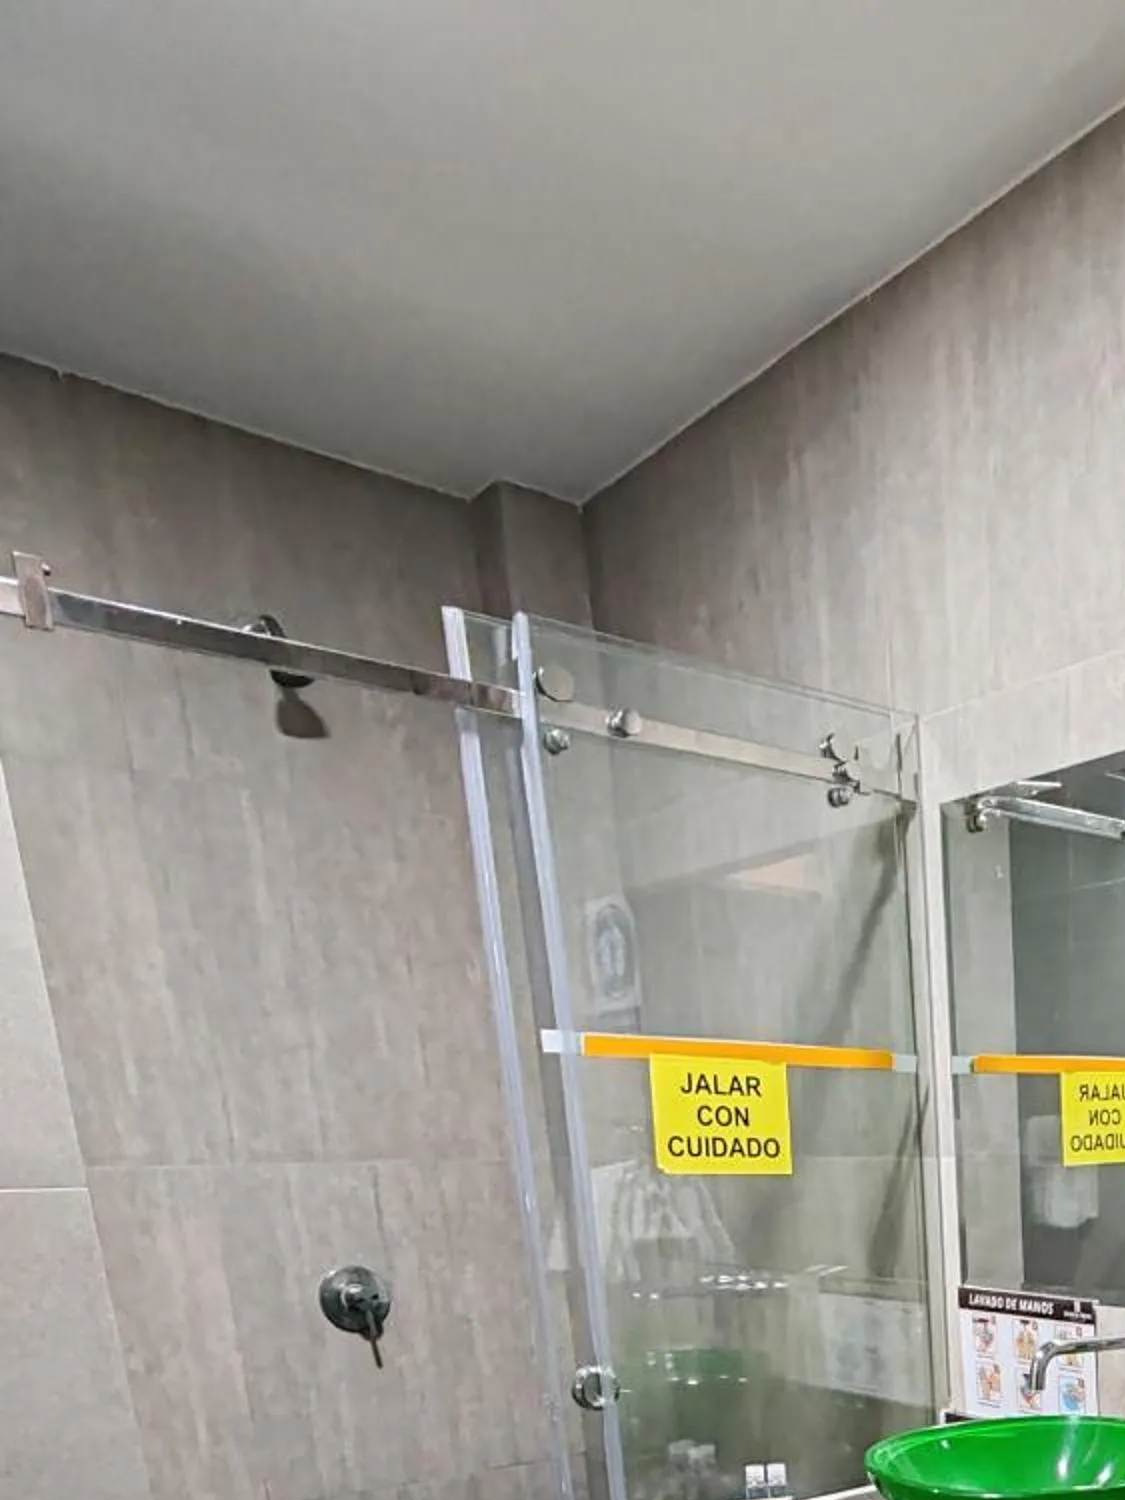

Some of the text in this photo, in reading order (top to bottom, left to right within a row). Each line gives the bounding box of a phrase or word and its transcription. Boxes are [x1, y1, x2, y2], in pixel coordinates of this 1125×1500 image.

[680, 1072, 763, 1097] JALAR
[697, 1105, 751, 1127] CON
[667, 1135, 781, 1158] CUIDADO
[969, 1293, 1004, 1309] LAVADO
[1005, 1297, 1017, 1310] DE
[1019, 1299, 1054, 1315] MANOS
